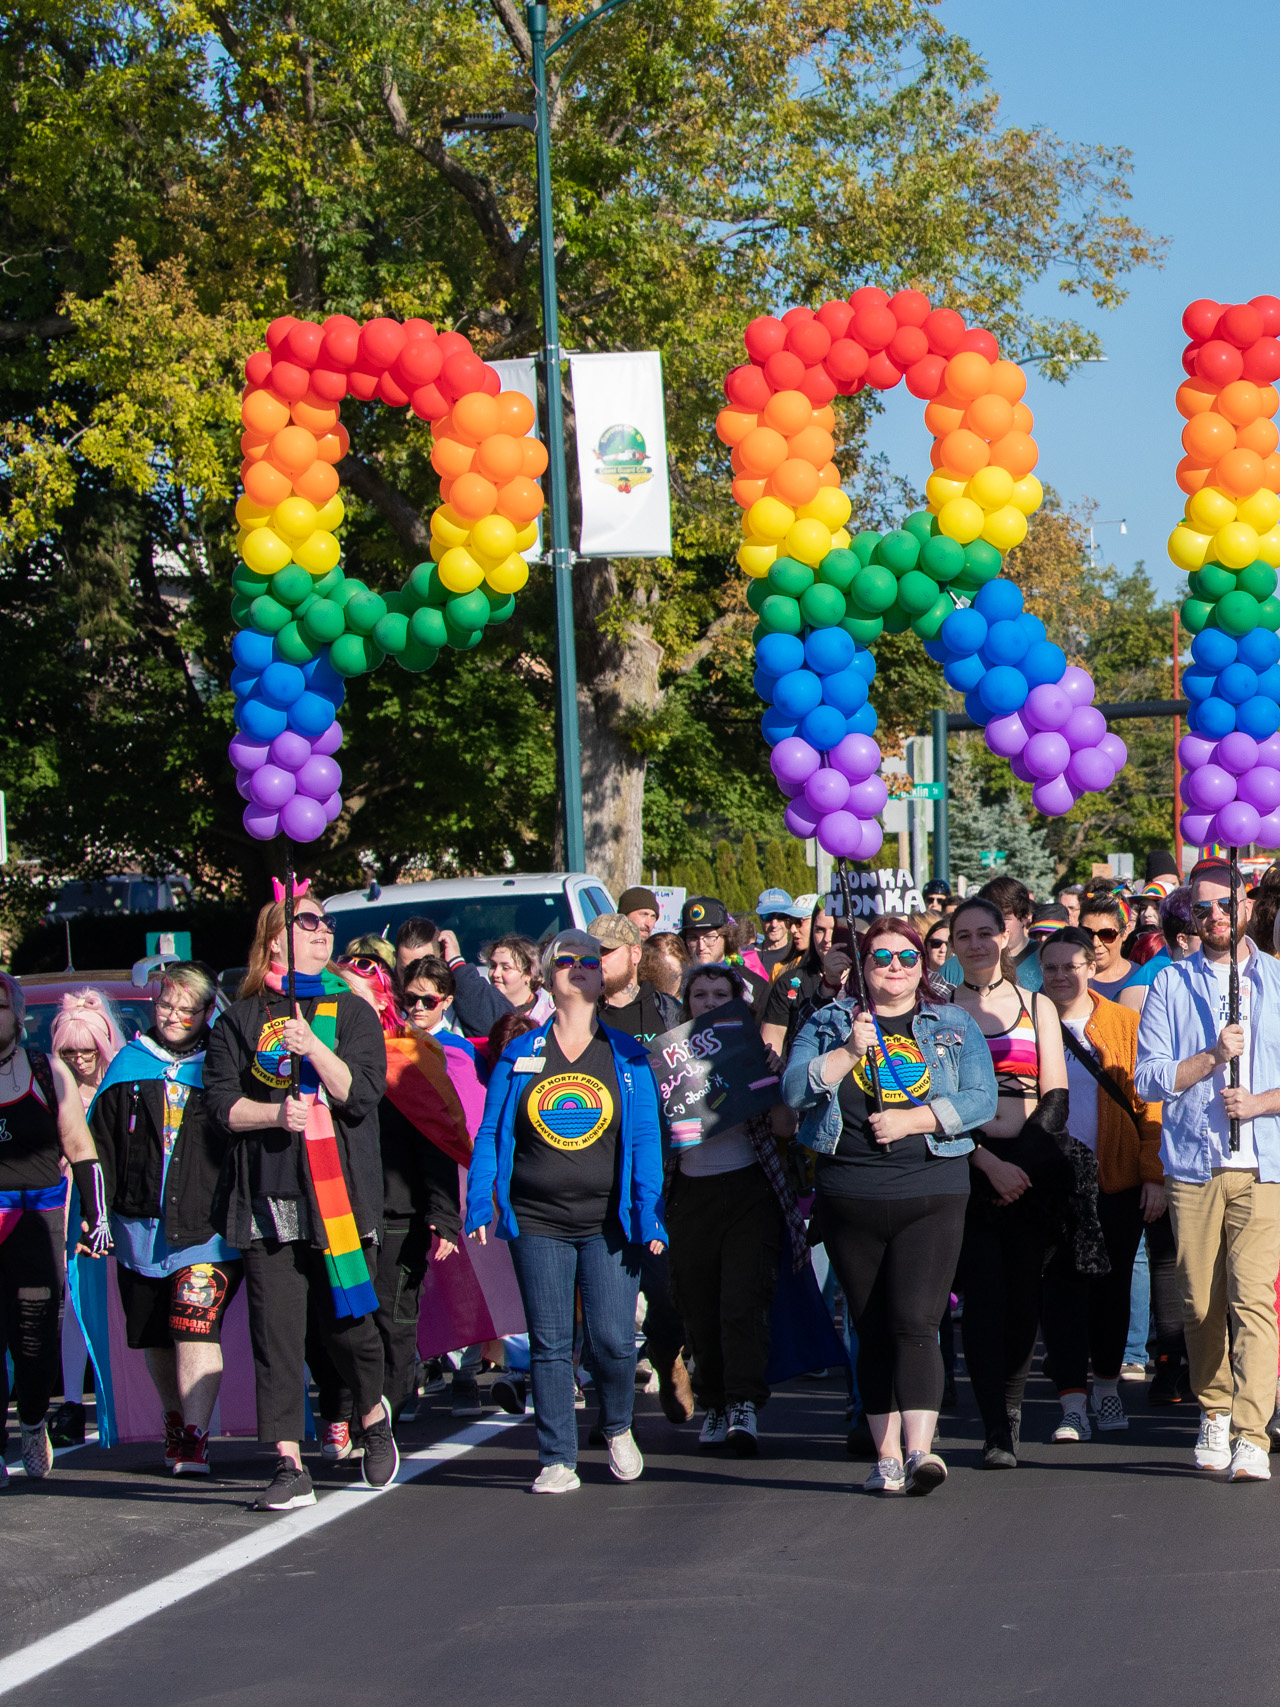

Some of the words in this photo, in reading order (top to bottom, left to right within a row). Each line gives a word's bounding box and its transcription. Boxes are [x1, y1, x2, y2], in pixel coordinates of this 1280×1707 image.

[831, 868, 914, 891] HONKA
[825, 889, 926, 917] HONKA
[535, 1085, 546, 1094] UP
[548, 1075, 579, 1086] NORTH
[581, 1076, 604, 1093] PRIDE
[660, 1062, 705, 1099] girls
[685, 1080, 712, 1105] about
[534, 1119, 561, 1145] TRAVERSE
[582, 1117, 608, 1145] MICHIGAN
